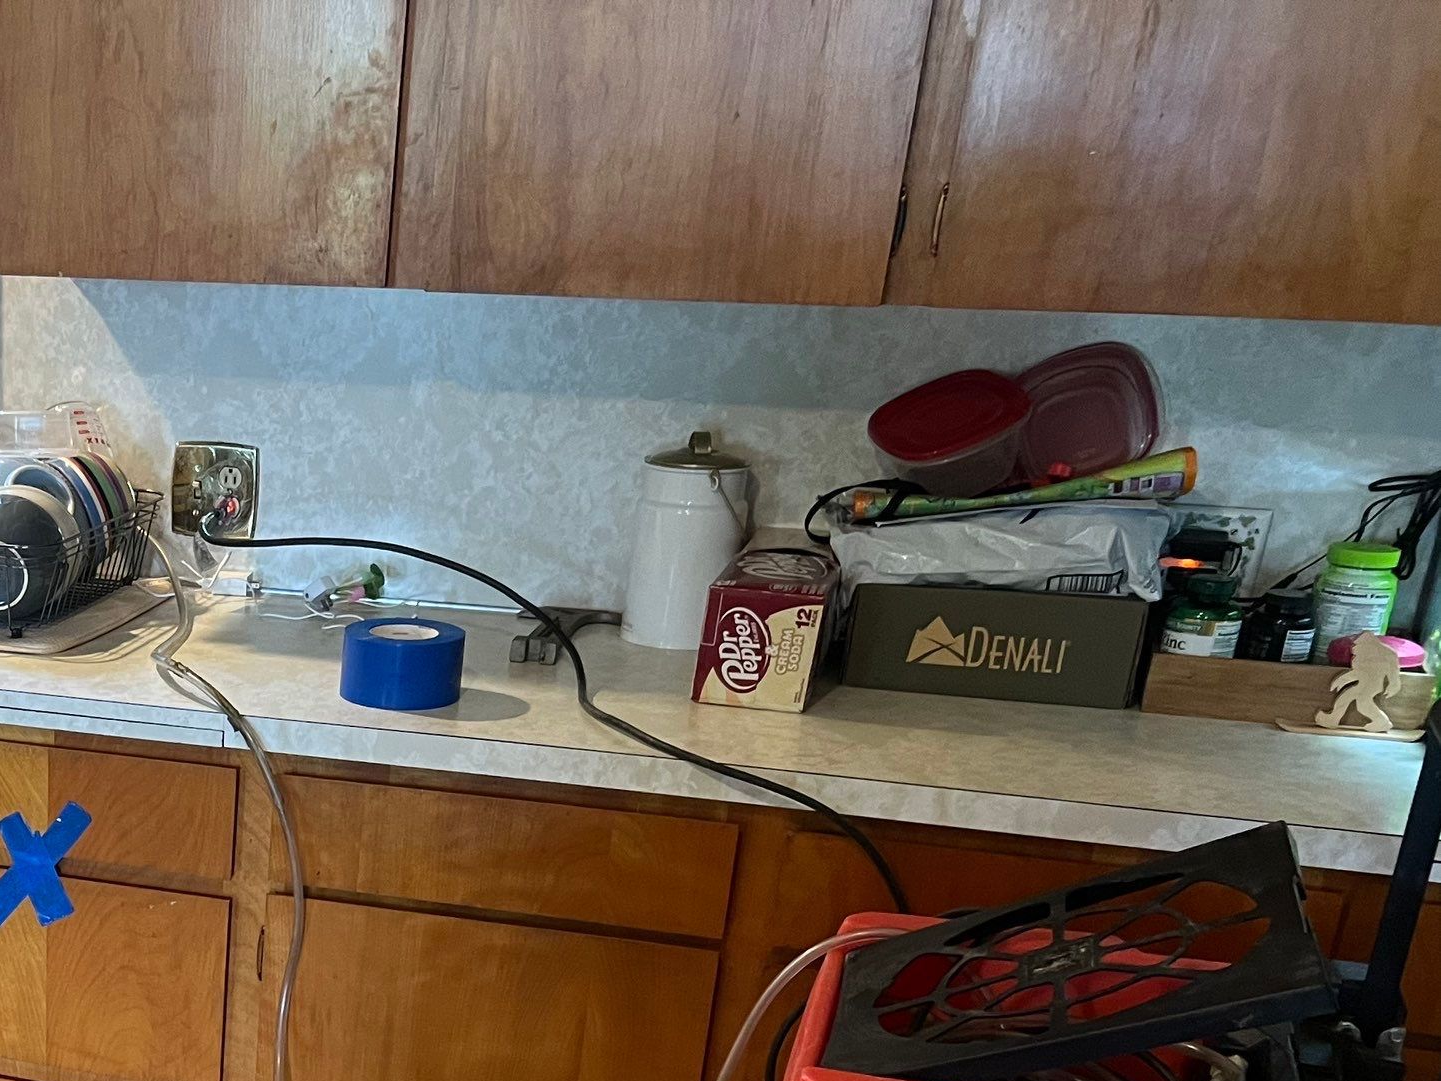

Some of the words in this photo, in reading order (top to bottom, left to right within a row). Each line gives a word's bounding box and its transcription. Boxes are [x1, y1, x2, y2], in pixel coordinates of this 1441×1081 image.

[795, 608, 813, 629] 12
[810, 609, 820, 628] PACK
[719, 630, 742, 661] Dr
[721, 613, 763, 689] Pepper
[764, 643, 779, 657] &
[774, 628, 795, 675] CREAM
[787, 634, 804, 672] SODA
[965, 625, 1066, 674] DENALI
